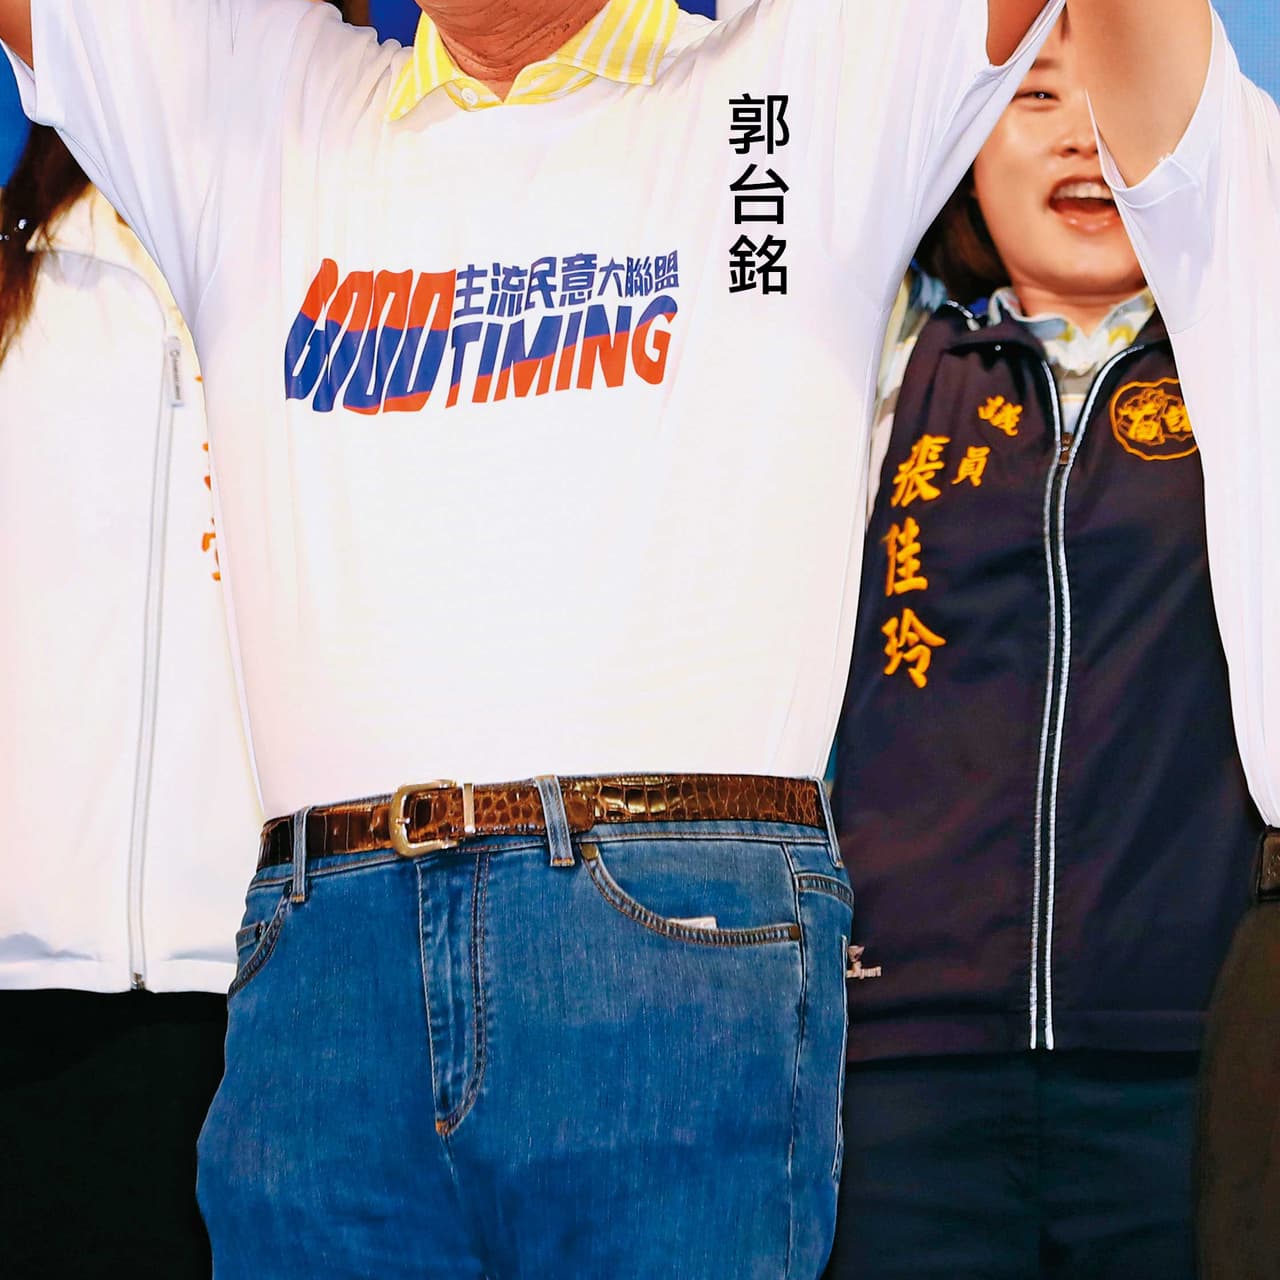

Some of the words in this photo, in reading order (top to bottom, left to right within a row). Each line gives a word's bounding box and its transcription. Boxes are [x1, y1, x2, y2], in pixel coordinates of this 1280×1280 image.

[285, 257, 457, 415] GOOD
[445, 295, 679, 408] TIMING
[454, 250, 680, 318] 主流民意大聯盟
[880, 433, 951, 689] 張佳玲
